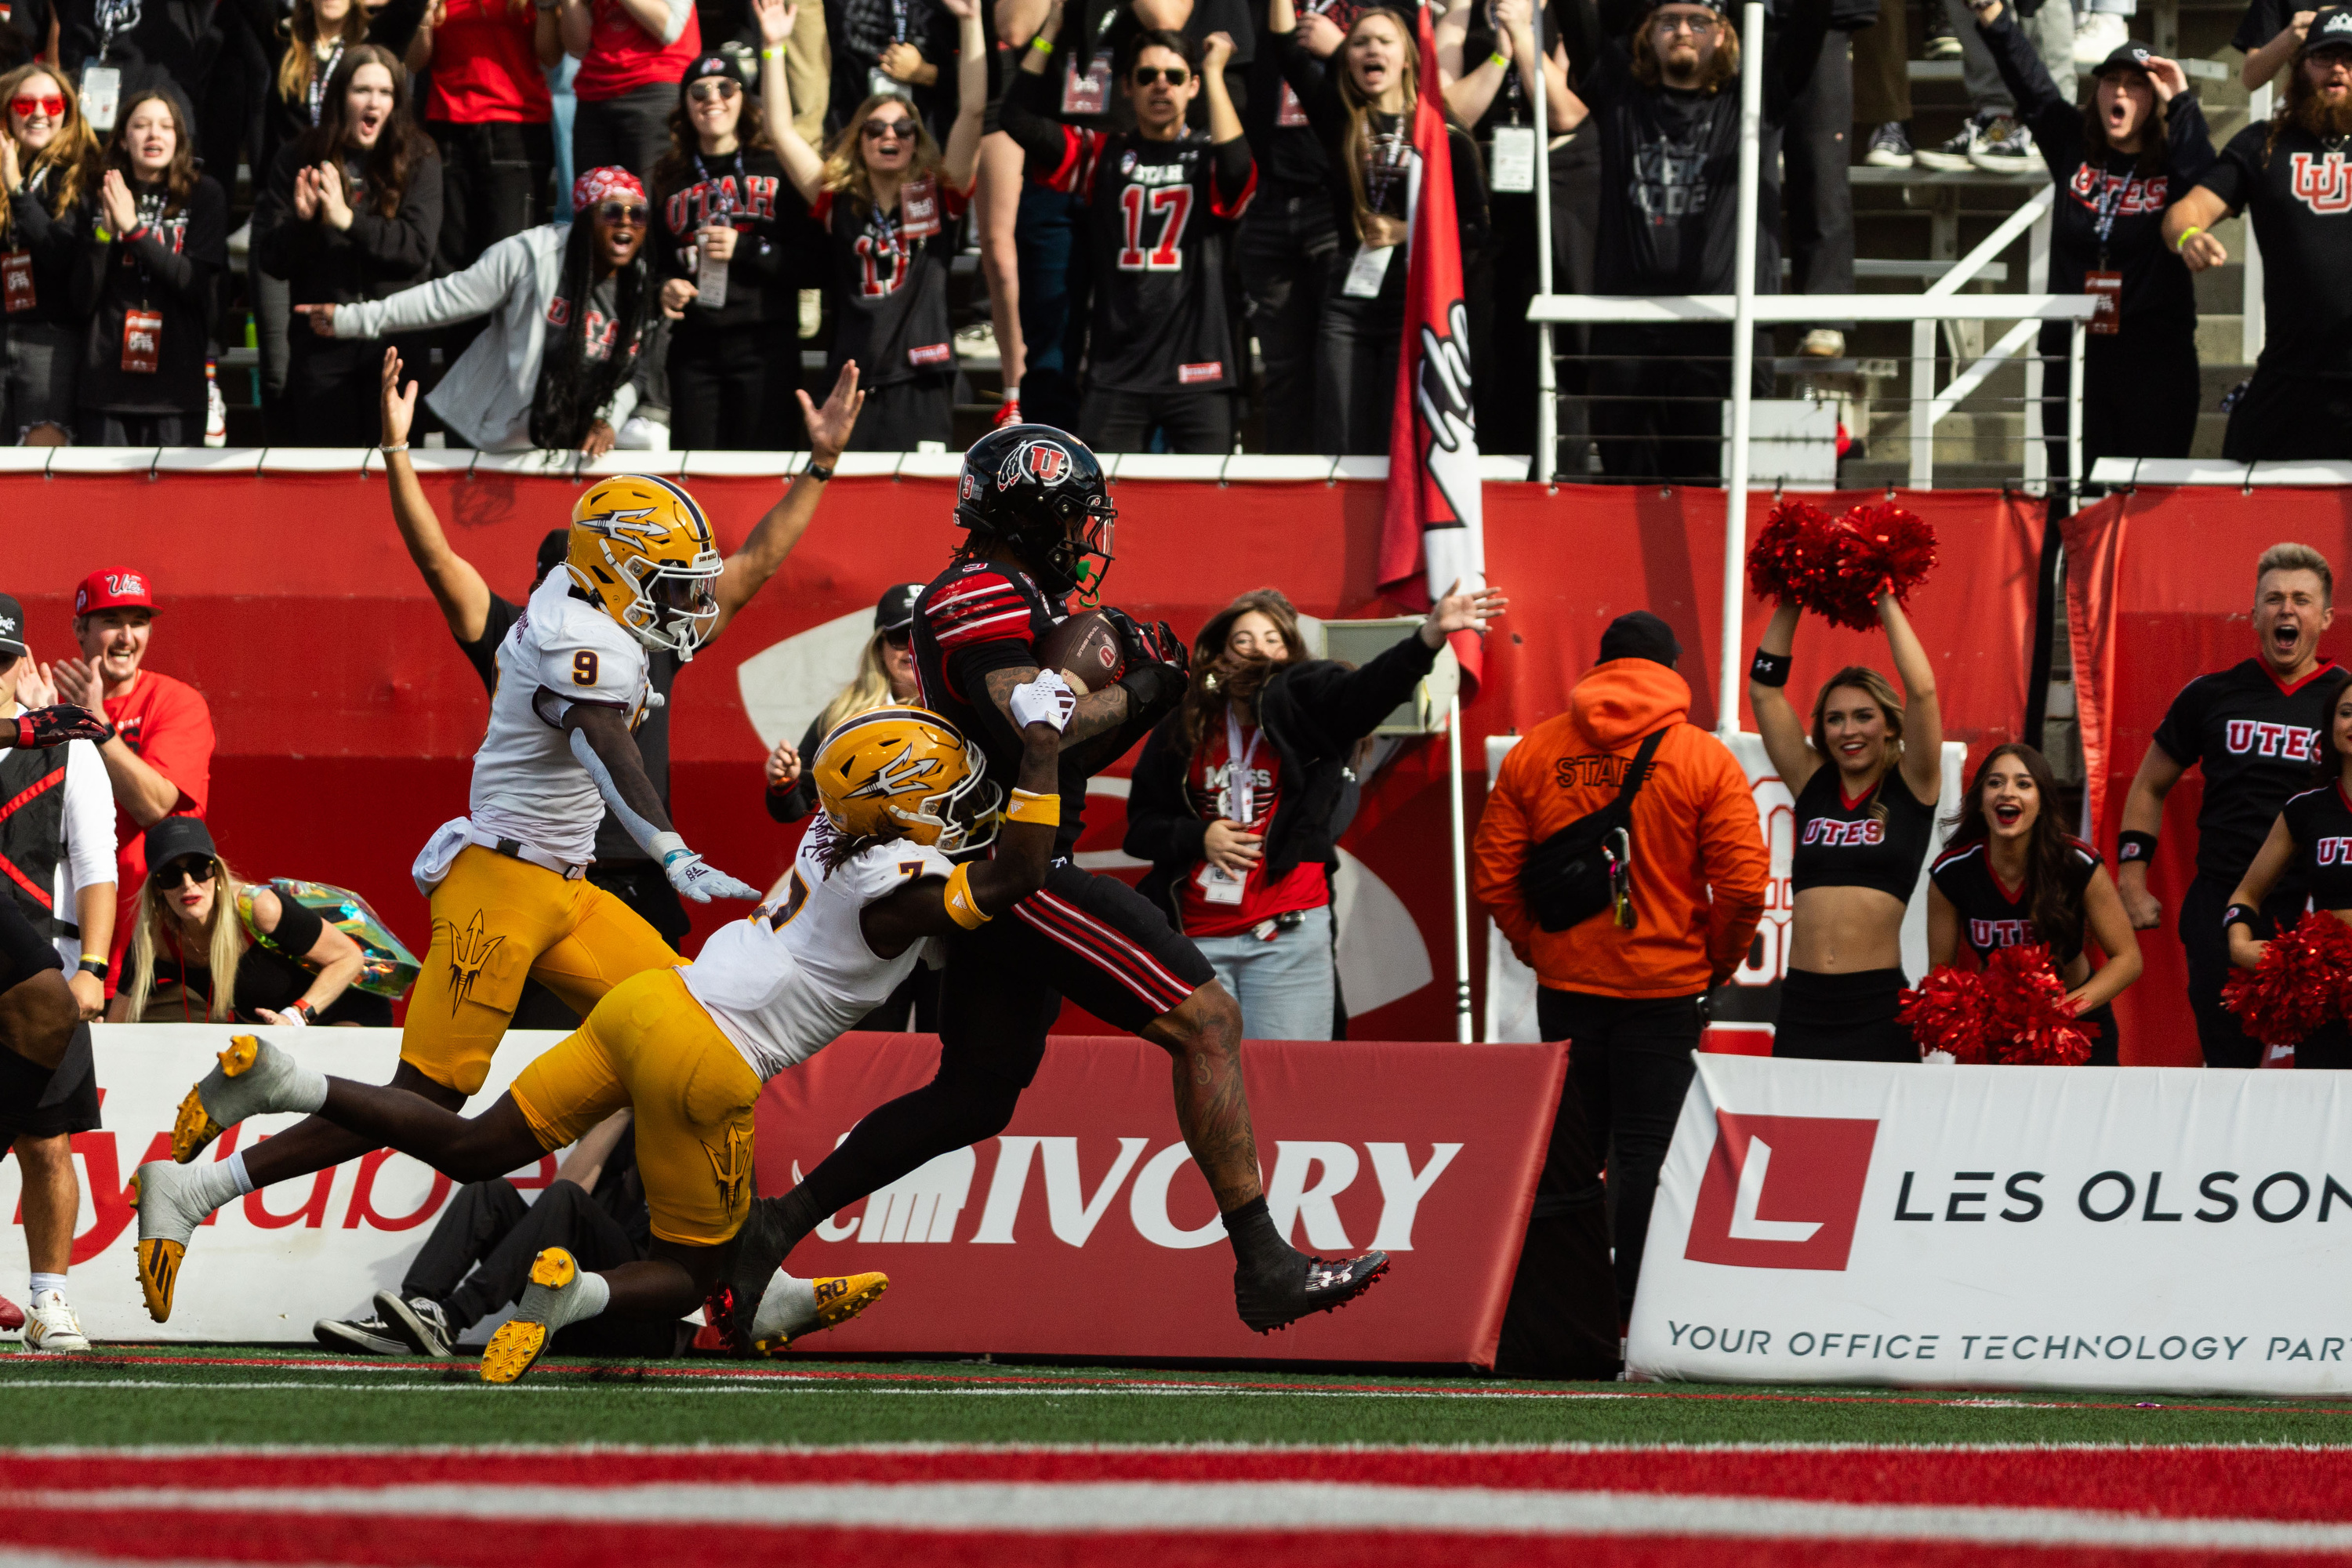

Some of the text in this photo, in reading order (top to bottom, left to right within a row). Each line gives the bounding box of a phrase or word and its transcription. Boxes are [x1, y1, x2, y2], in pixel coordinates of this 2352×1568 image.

[666, 175, 779, 235] UTAH
[1117, 183, 1193, 271] 17
[1030, 445, 1065, 481] U
[962, 474, 975, 499] 3
[104, 574, 145, 597] Utes
[1076, 625, 1099, 659] TEAM ISSUE
[572, 649, 599, 687] 9
[1802, 817, 1885, 846] UTES
[898, 859, 925, 880] 7
[1969, 918, 2034, 948] UTE
[968, 1136, 1464, 1250] IVORY
[1894, 1171, 2045, 1222] LES
[1668, 1320, 2352, 1362] YOUR OFFICE TECHNOLOGY PAR
